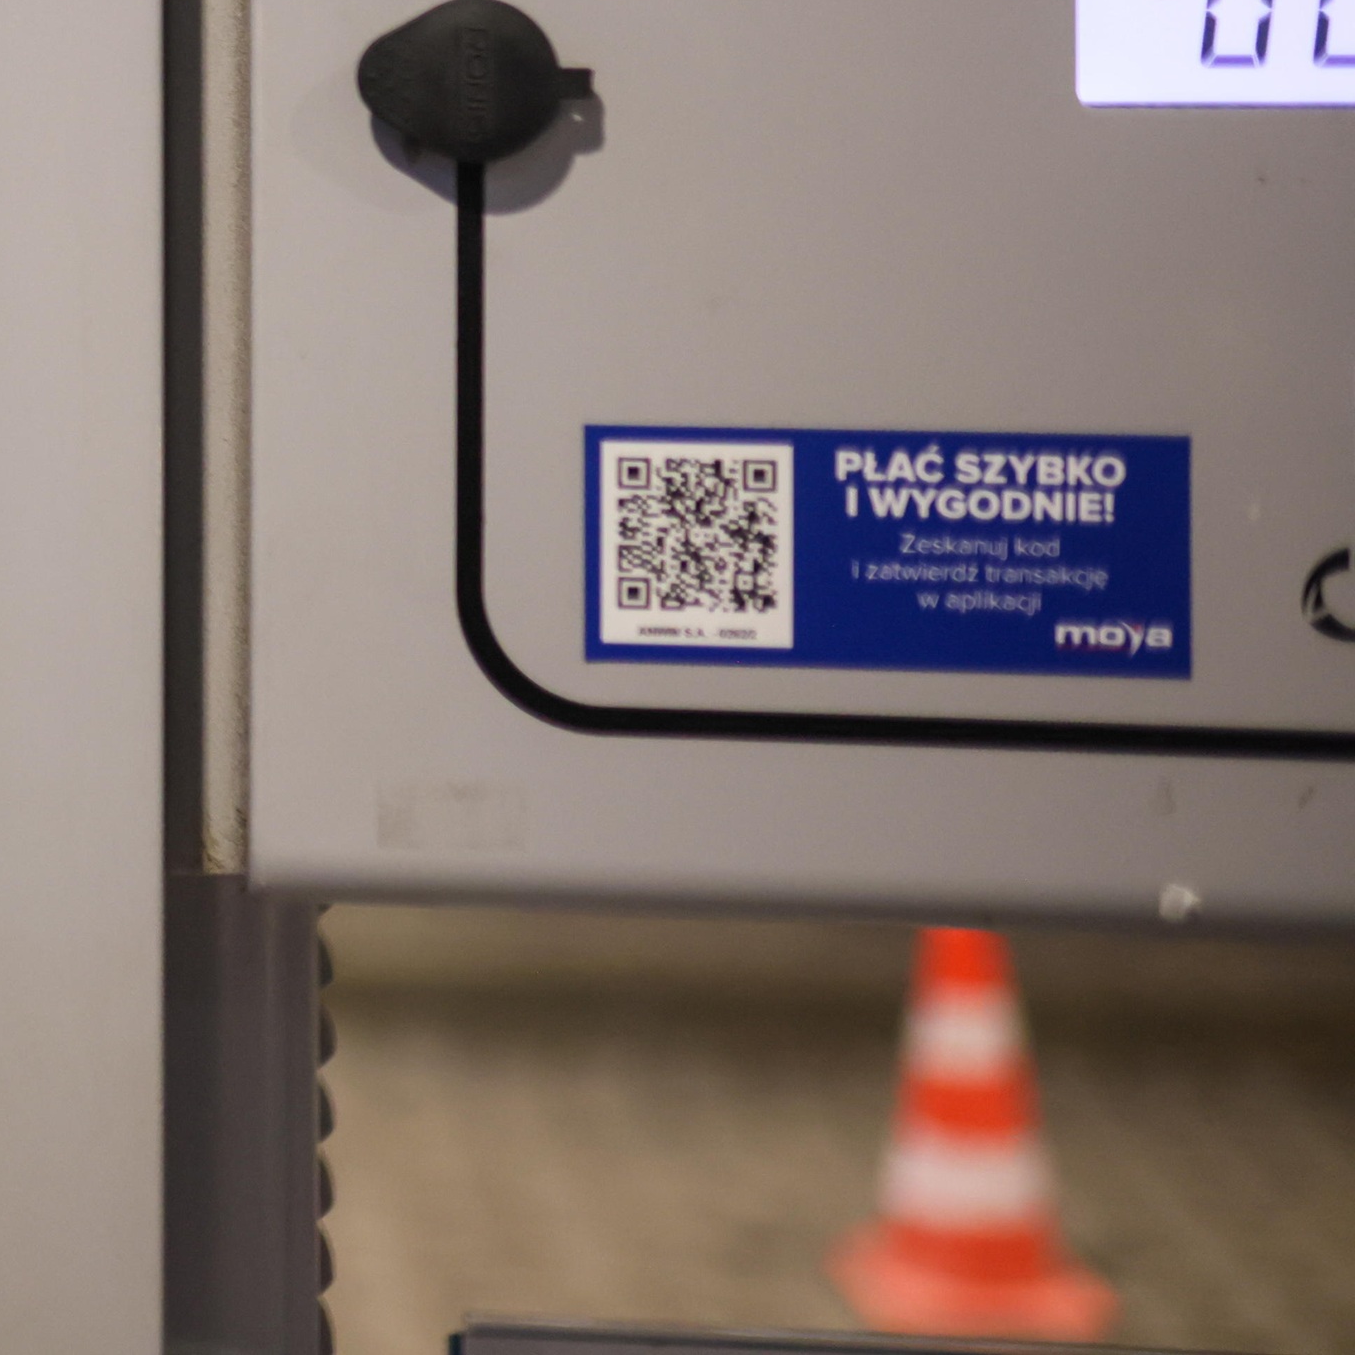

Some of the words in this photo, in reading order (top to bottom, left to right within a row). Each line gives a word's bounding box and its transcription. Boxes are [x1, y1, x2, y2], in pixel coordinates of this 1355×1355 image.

[835, 442, 945, 483] PŁAĆ
[954, 452, 1127, 487] SZYBKO
[845, 486, 859, 518] I
[868, 487, 1115, 523] WYGODNIE!
[900, 533, 1009, 561] Zeskanuj
[1013, 536, 1061, 558] kod
[984, 564, 1110, 590] transakcję
[916, 593, 939, 609] w
[943, 592, 1043, 616] aplikacji
[1055, 621, 1174, 657] moya
